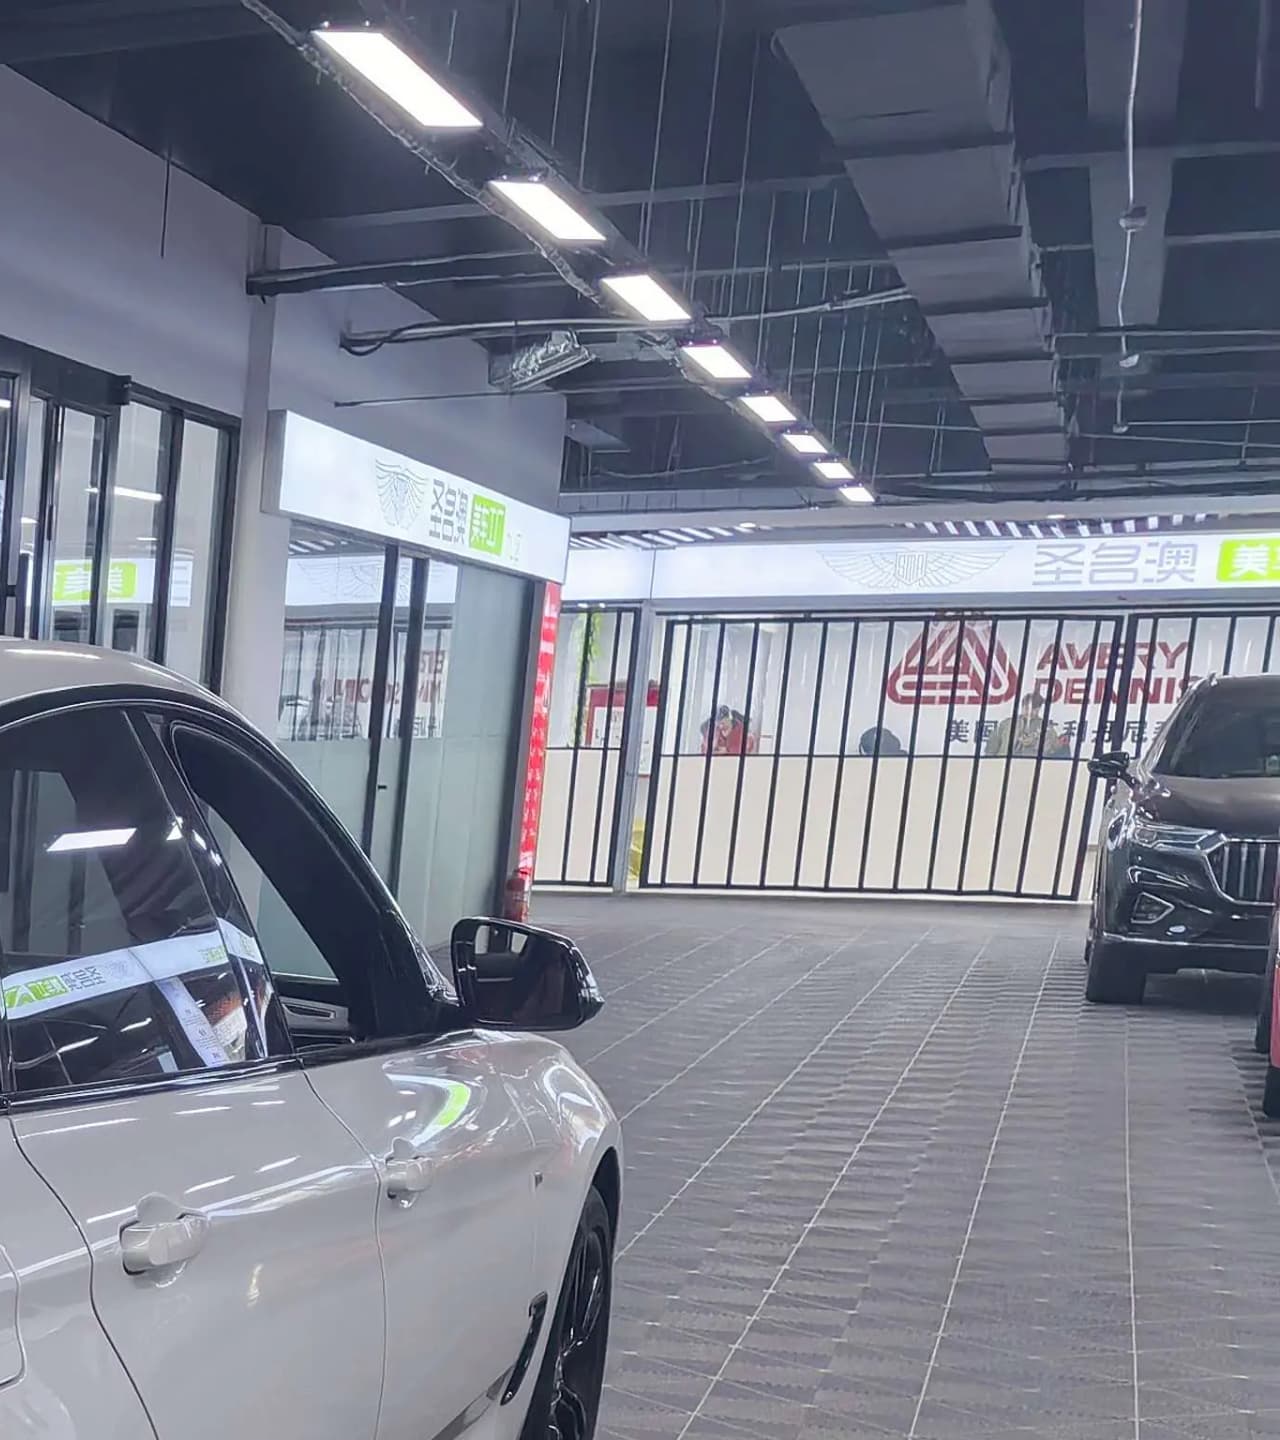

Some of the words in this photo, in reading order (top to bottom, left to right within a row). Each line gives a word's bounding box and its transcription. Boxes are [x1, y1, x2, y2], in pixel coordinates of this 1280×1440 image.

[1032, 541, 1199, 586] 圣名澳
[1232, 543, 1280, 578] 美
[1037, 642, 1188, 671] AVERY
